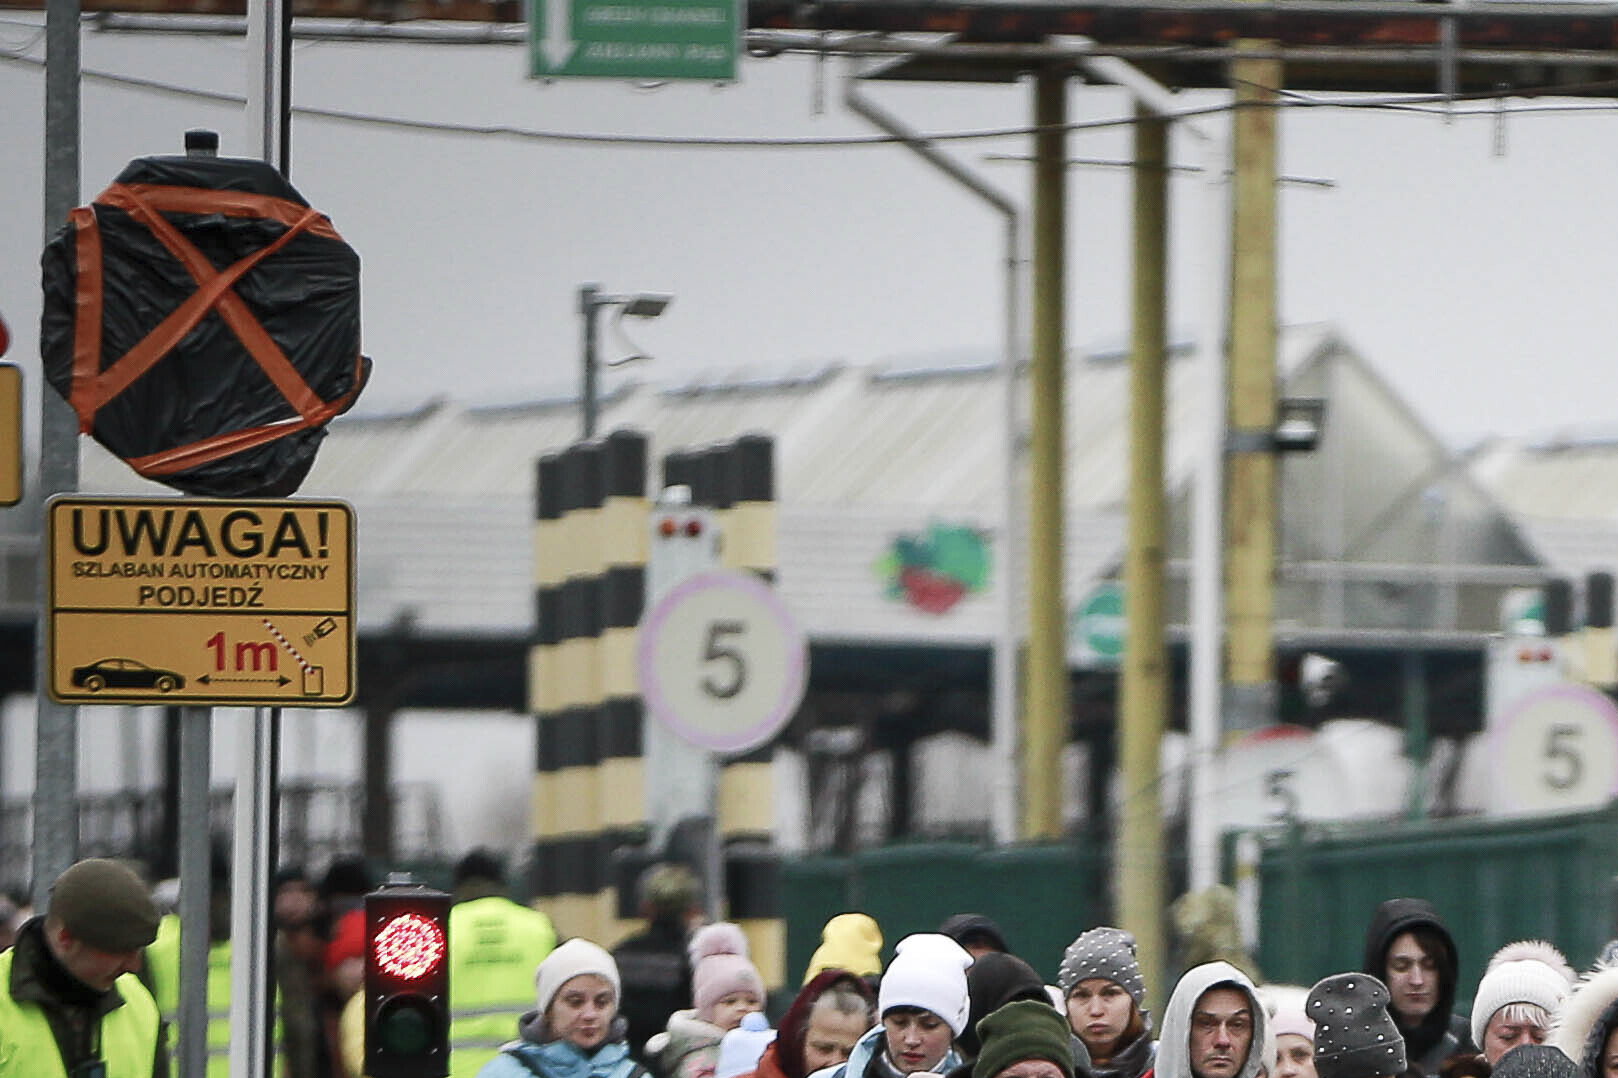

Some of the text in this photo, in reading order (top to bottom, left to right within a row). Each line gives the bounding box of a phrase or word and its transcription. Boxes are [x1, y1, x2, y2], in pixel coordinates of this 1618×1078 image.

[71, 508, 329, 558] UWAGA!
[72, 561, 329, 580] SZLABAN AUTOMATYCZNY
[138, 581, 264, 608] PODJEDŹ
[206, 631, 279, 673] 1m
[699, 621, 749, 700] 5
[1542, 723, 1583, 791] 5
